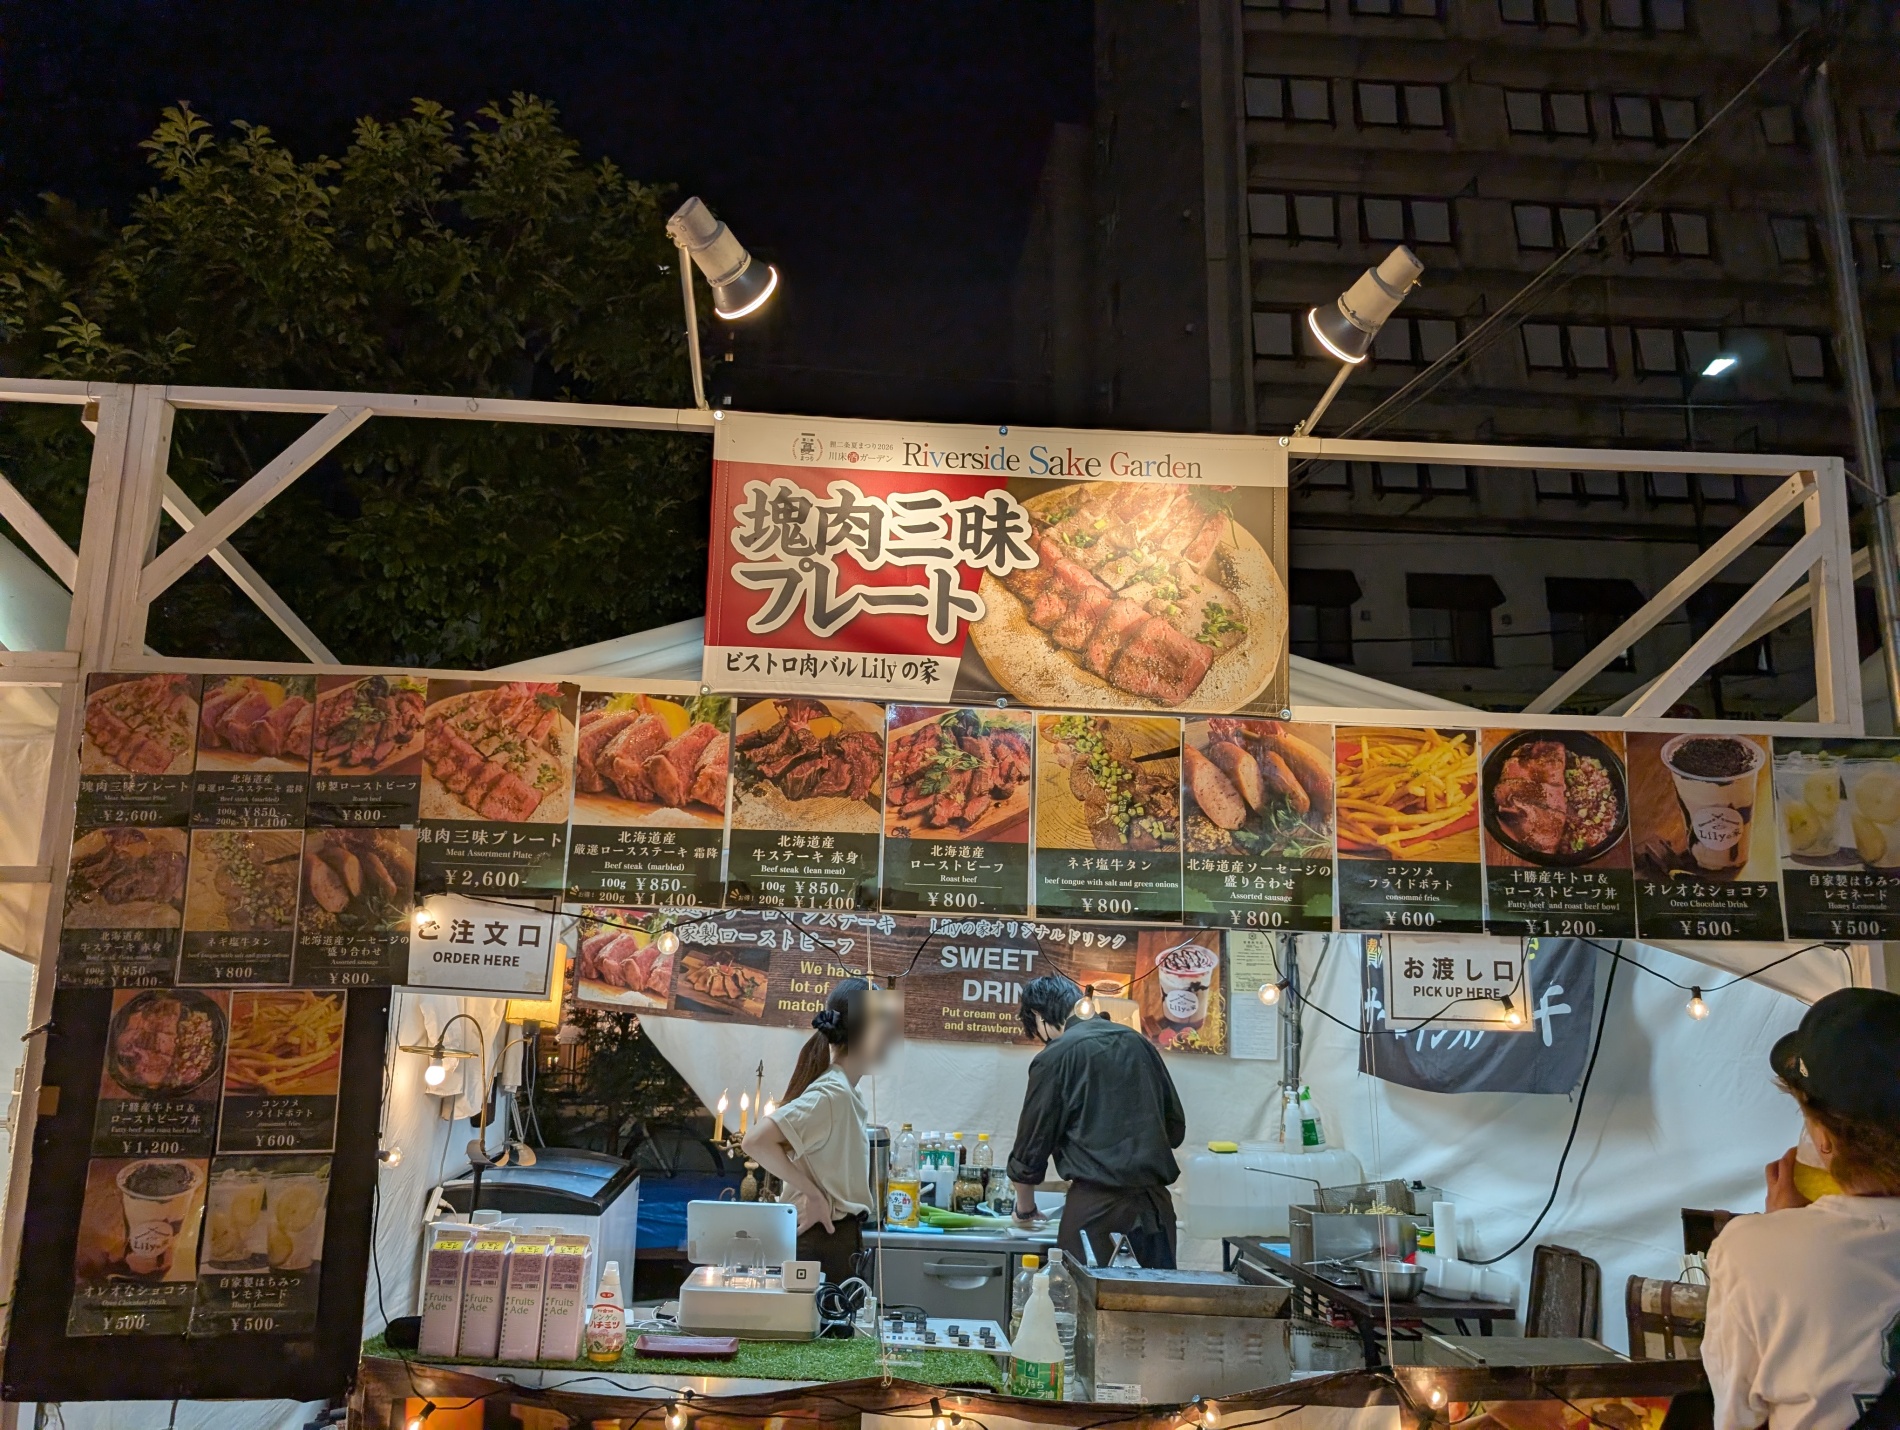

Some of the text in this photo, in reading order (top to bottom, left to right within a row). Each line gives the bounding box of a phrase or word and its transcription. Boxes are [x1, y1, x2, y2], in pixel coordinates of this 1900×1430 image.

[902, 442, 1203, 478] Riverside Sake Garden
[738, 483, 1034, 570] 塊肉三昧
[738, 557, 979, 638] プレート
[316, 781, 417, 792] 特製ローストビーフ
[343, 809, 387, 822] ¥800-
[417, 828, 562, 848] 塊肉三昧プレート
[618, 831, 676, 845] 北海道産
[778, 835, 835, 849] 北海道産
[446, 848, 533, 859] Meat Assortment Plate
[573, 843, 719, 859] 厳選ロースステーキ 霜降
[752, 849, 859, 864] 牛ステーキ 赤身
[931, 844, 985, 859] 北海道産
[604, 861, 622, 869] Beef
[647, 862, 685, 872] (marbled)
[761, 865, 779, 873] Beef
[803, 866, 822, 875] (lean
[824, 867, 846, 875] meat)
[911, 860, 1004, 873] ローストビーフ
[1067, 857, 1152, 871] ネギ塩牛タン
[1187, 859, 1331, 877] 北海道産ソーセージの
[1387, 867, 1434, 876] コンソメ
[1510, 870, 1609, 884] 十勝産牛トロ&
[445, 869, 527, 888] ¥2,600-
[600, 877, 687, 891] 100g ¥850-
[940, 875, 978, 883] Roast beef
[1045, 877, 1060, 885] beef
[1061, 878, 1085, 886] tongue
[1104, 879, 1118, 887] salt
[1134, 881, 1154, 889] green
[1224, 875, 1296, 890] 盛り合わせ
[1369, 878, 1453, 891] フライドポテト
[1809, 874, 1900, 887] 自家製はちみつ
[760, 881, 845, 895] 100g ¥850-
[1505, 887, 1617, 900] ローストビーフ丼
[1644, 882, 1769, 898] オレオなショコラ
[599, 892, 625, 903] 200g
[759, 895, 785, 907] 200g
[928, 892, 985, 908] ¥800-
[1230, 892, 1292, 902] Assorted sausage
[1424, 894, 1440, 902] fries
[1824, 889, 1887, 901] レモネード
[1081, 897, 1139, 914] ¥800-
[1507, 900, 1526, 909] Fatty
[1528, 901, 1545, 909] beef
[1584, 902, 1599, 910] beef
[1689, 900, 1726, 908] Chocolate
[1727, 900, 1748, 908] Drink
[1828, 902, 1850, 910] Honey
[1230, 910, 1289, 927] ¥800-
[1385, 911, 1442, 927] ¥600-
[418, 918, 541, 947] ご注文口
[1525, 919, 1604, 936] ¥1,200-
[1680, 920, 1740, 936] ¥500-
[1830, 920, 1887, 936] ¥500-
[208, 937, 271, 947] ネギ塩牛タン
[300, 935, 410, 946] 北海道産ソーセージの
[327, 946, 382, 957] 盛り合わせ
[432, 951, 520, 967] ORDER HERE
[941, 946, 1039, 972] SWEET
[801, 960, 822, 975] We
[1403, 957, 1514, 982] お渡し口
[329, 972, 375, 985] ¥800-
[790, 979, 830, 994] lot of
[1413, 986, 1500, 999] PICK UP HERE
[942, 1007, 960, 1017] Put
[963, 1010, 996, 1019] cream
[944, 1021, 964, 1031] and
[231, 1289, 287, 1300] レモネード
[470, 1294, 493, 1303] Fruits
[428, 1302, 447, 1311] Ade
[469, 1304, 487, 1312] Ade
[510, 1297, 535, 1306] Fruits
[551, 1298, 574, 1307] Fruits
[509, 1306, 529, 1314] Ade
[550, 1307, 568, 1315] Ade
[231, 1317, 280, 1331] ¥500-
[590, 1321, 620, 1329] ハチミツ
